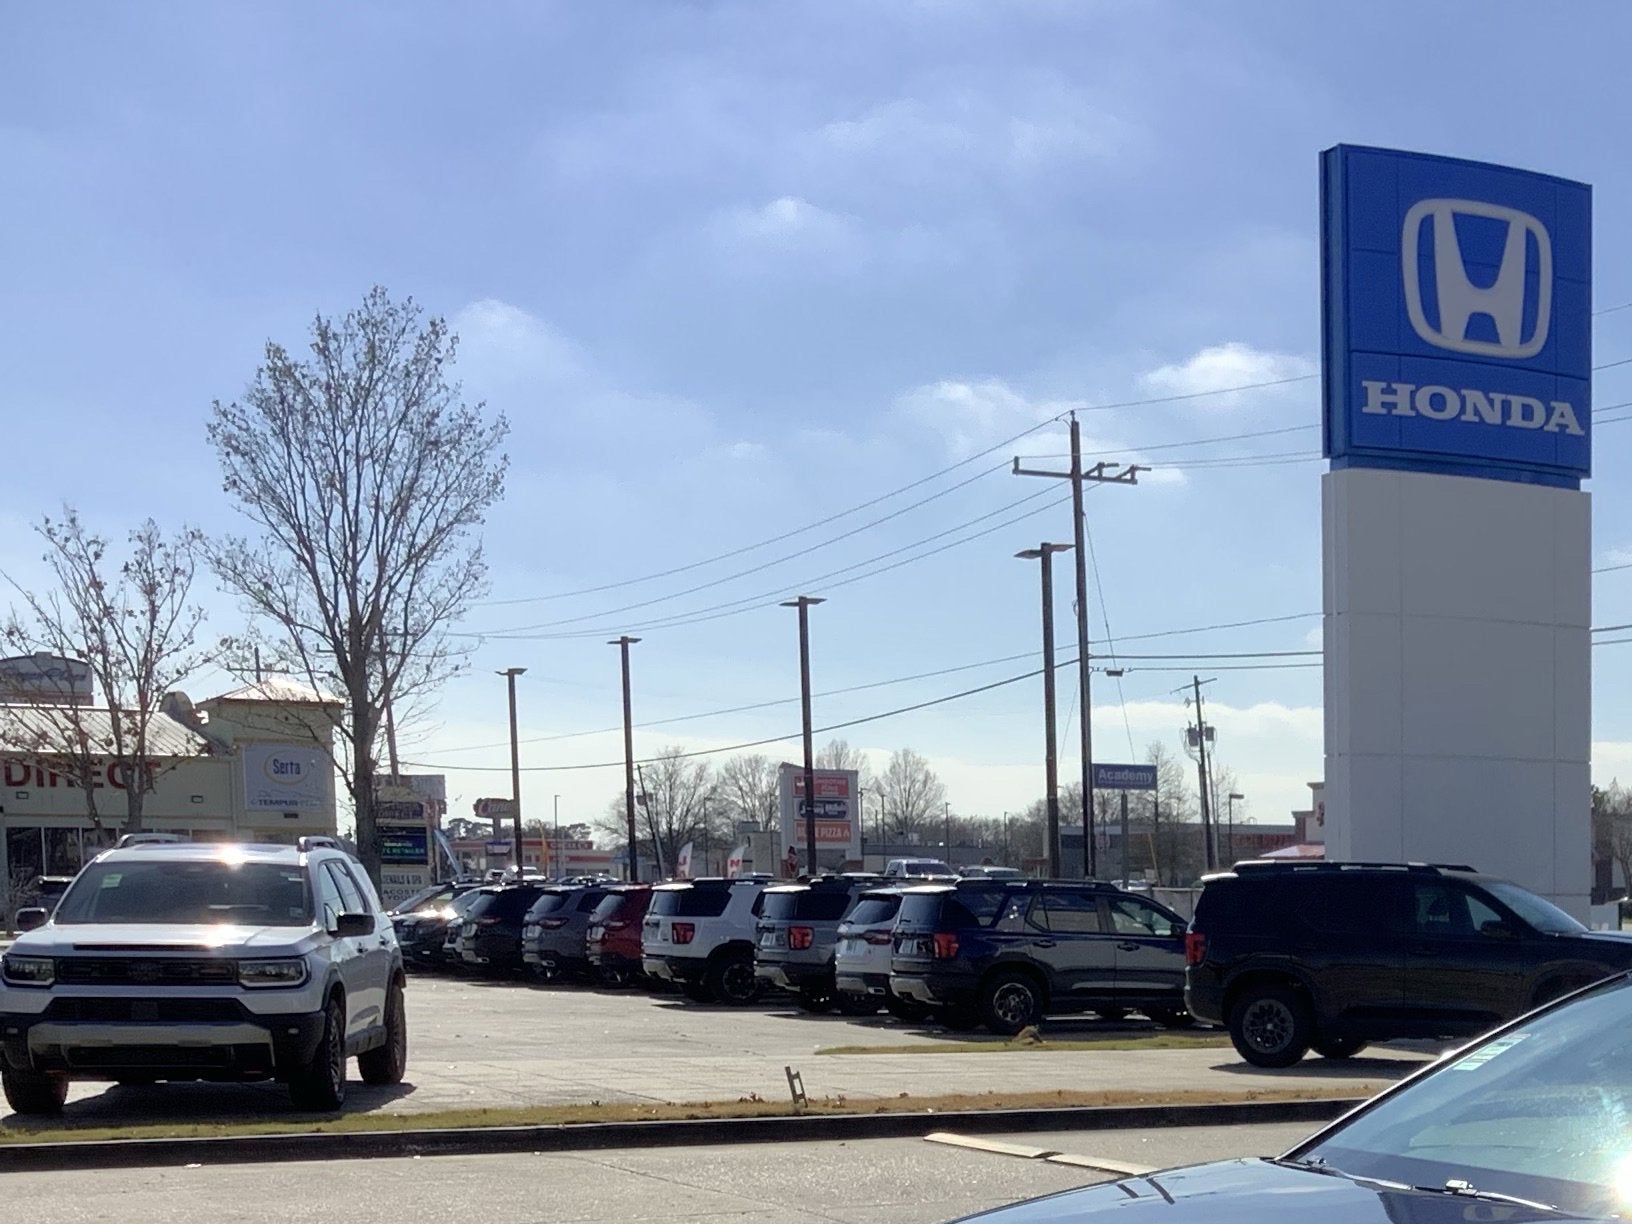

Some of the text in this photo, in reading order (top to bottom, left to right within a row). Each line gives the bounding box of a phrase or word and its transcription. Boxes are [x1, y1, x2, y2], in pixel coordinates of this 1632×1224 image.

[1362, 381, 1585, 435] HONDA
[273, 759, 301, 775] Serta
[1098, 768, 1154, 785] Academy
